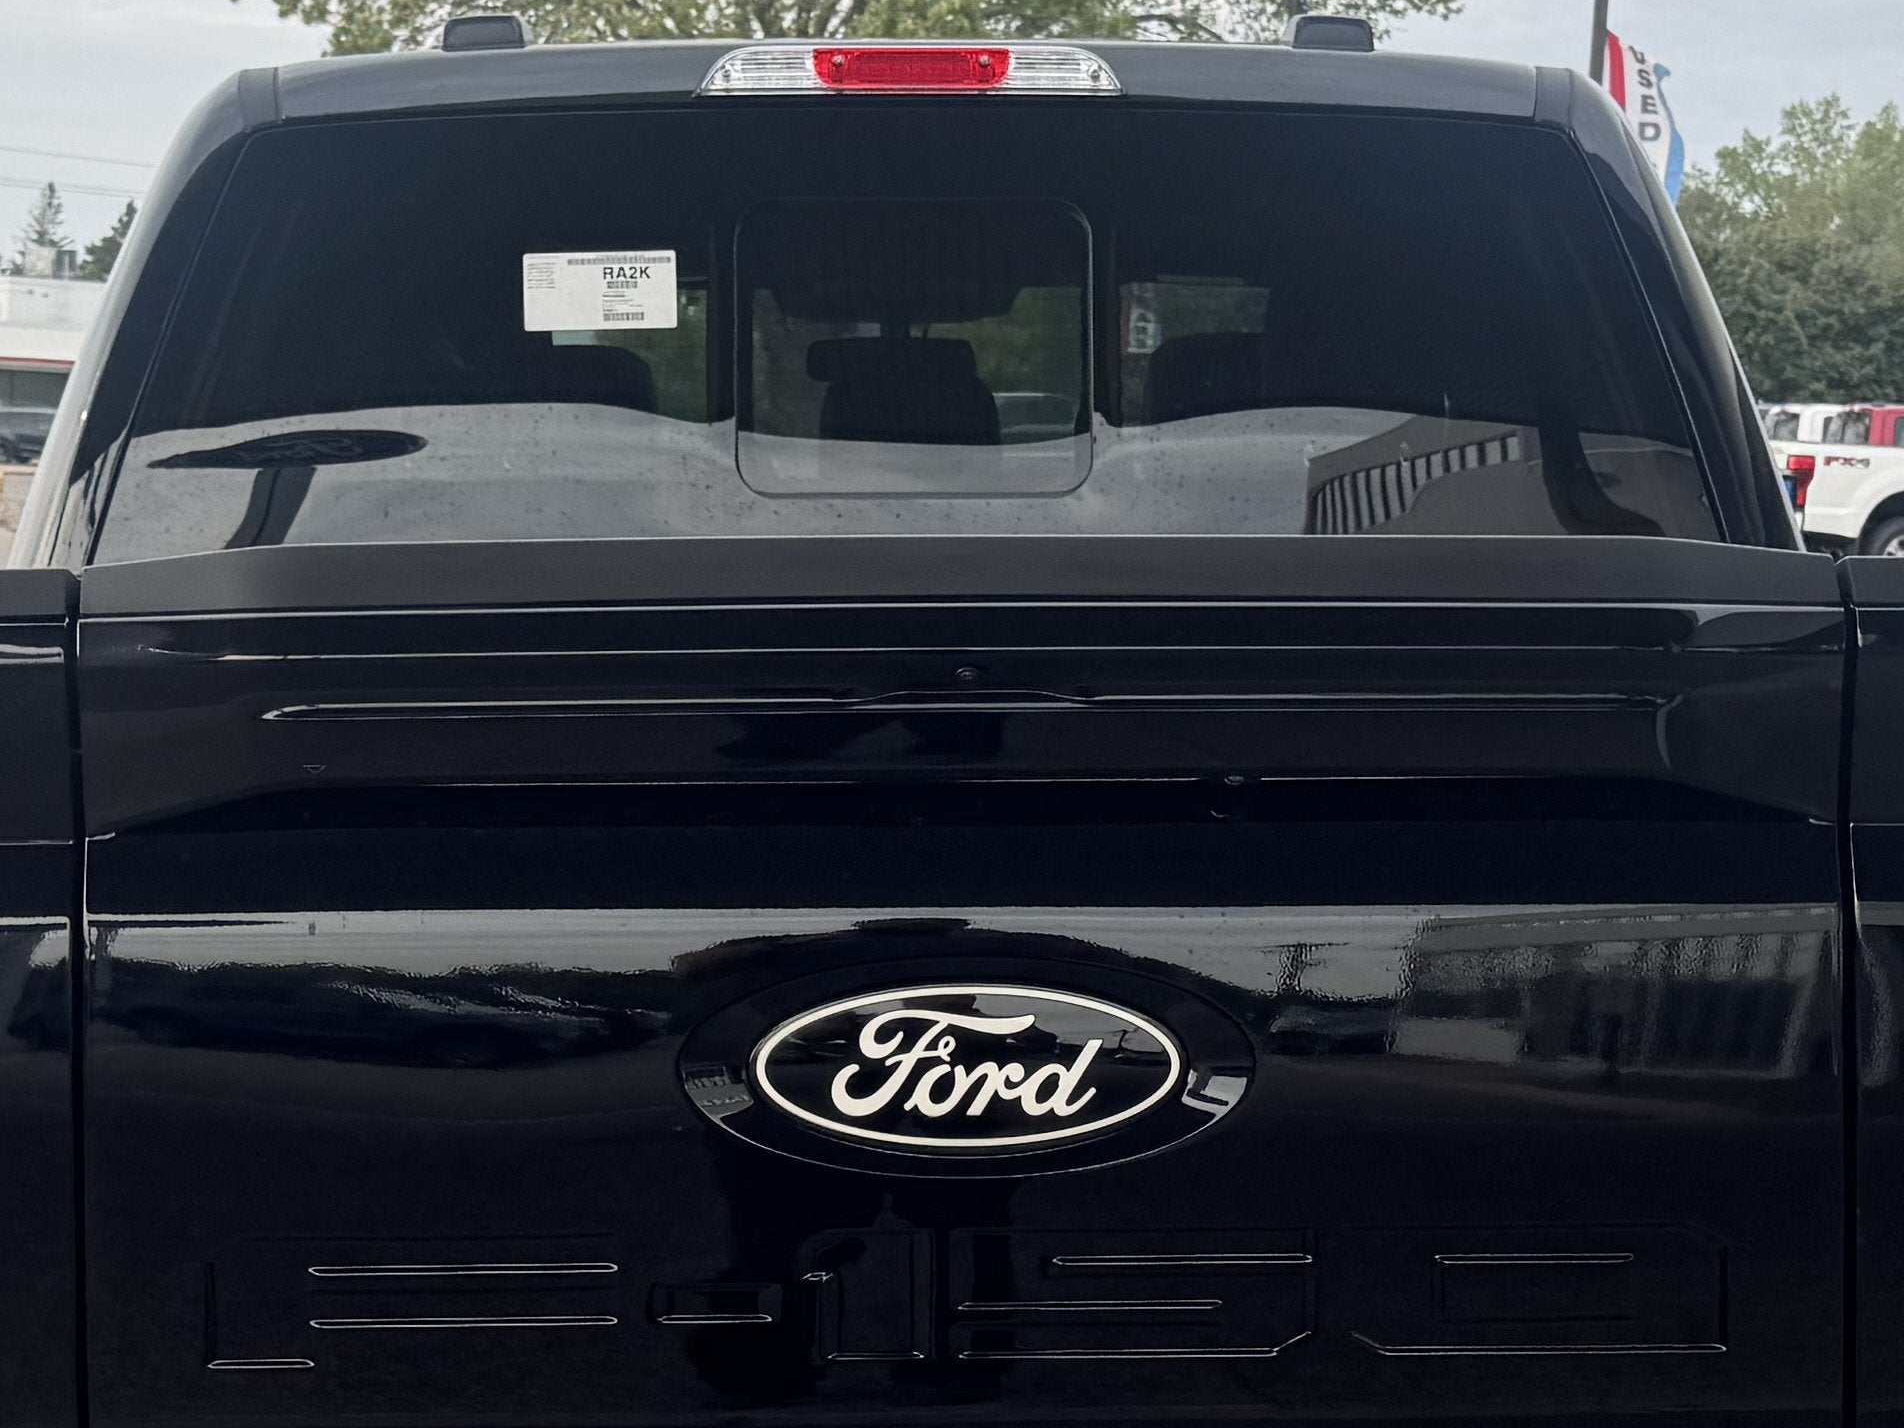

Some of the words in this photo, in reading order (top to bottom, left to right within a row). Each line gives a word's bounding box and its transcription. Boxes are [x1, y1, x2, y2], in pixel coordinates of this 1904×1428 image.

[1627, 44, 1662, 142] USED
[603, 266, 651, 280] RA2K
[830, 1008, 1103, 1117] Ford
